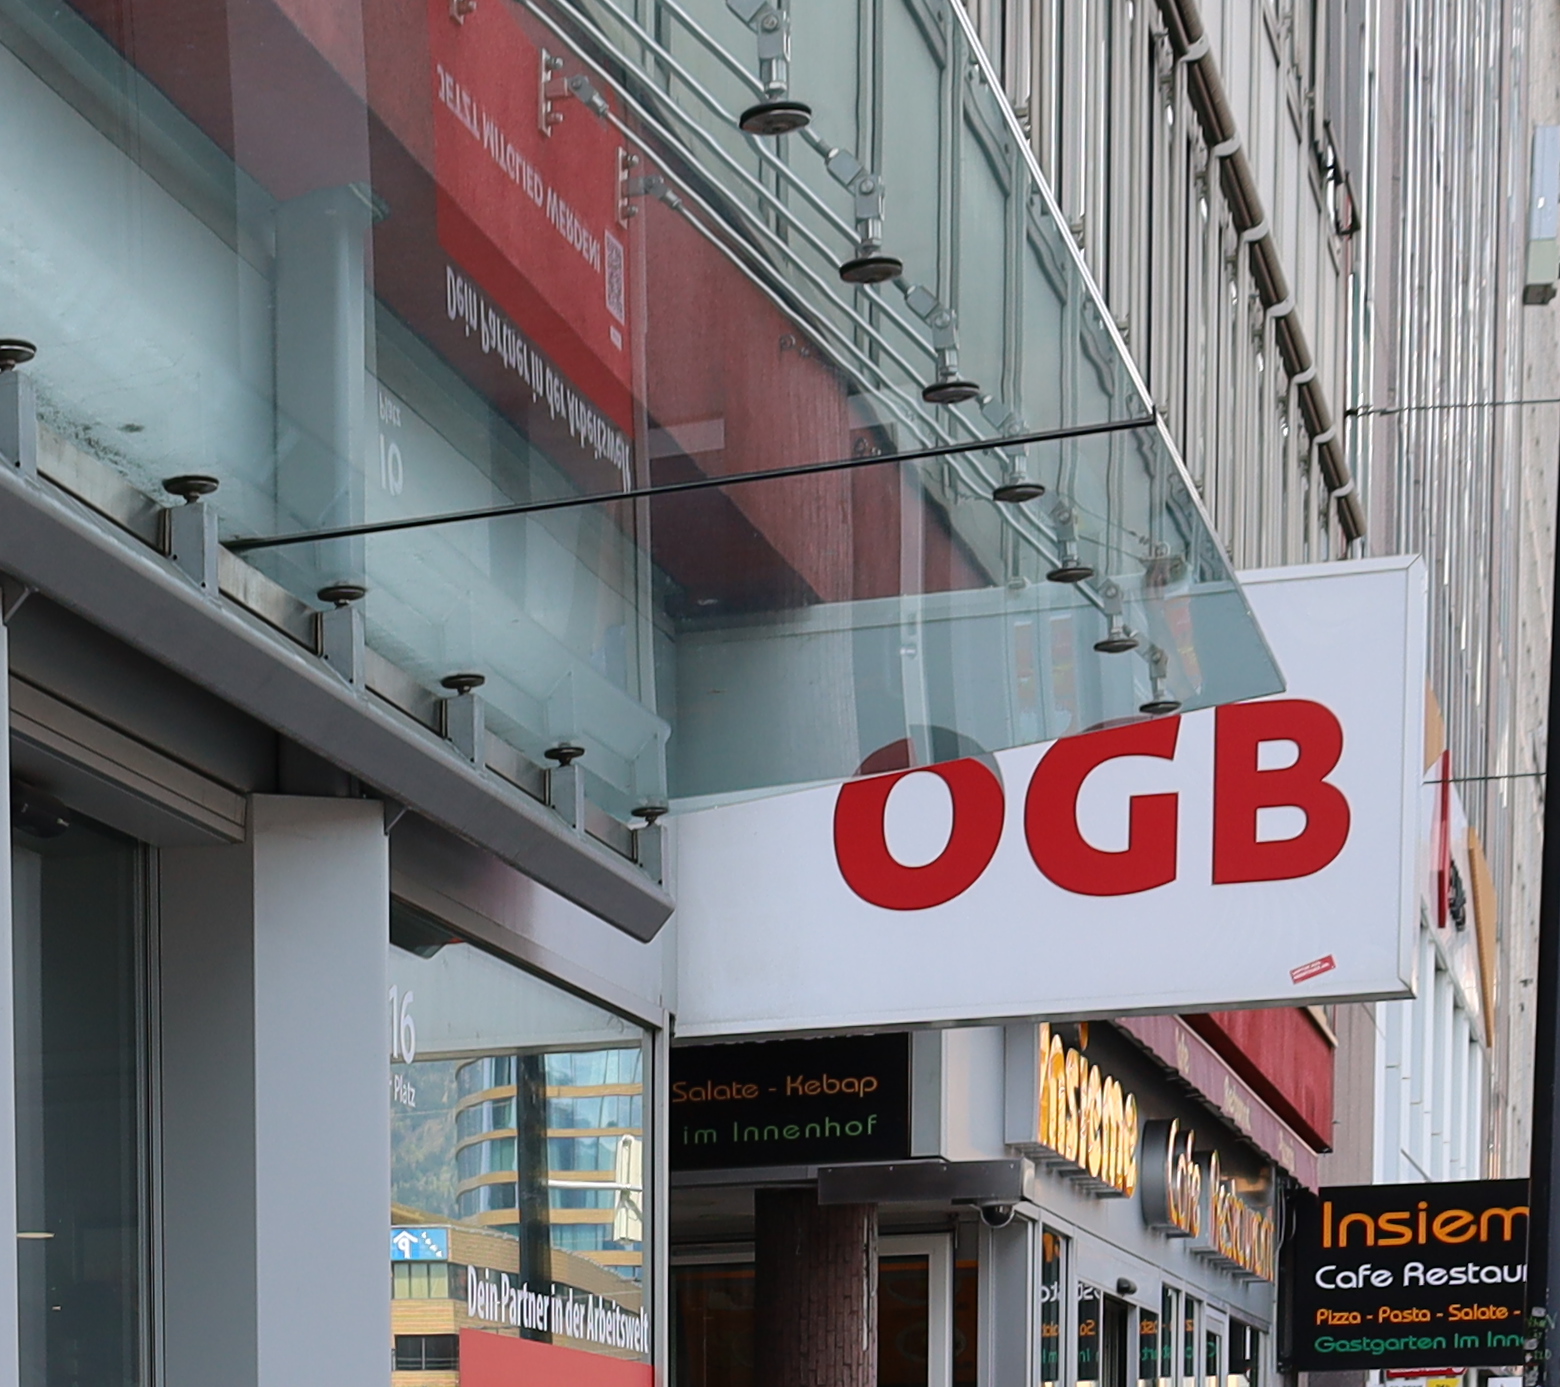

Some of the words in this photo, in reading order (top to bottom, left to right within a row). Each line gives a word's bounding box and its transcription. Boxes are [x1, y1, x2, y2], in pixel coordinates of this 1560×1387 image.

[389, 984, 416, 1064] 16
[671, 1080, 759, 1103] Salate
[786, 1073, 878, 1099] Kebap
[683, 1126, 717, 1146] im
[733, 1113, 879, 1142] Innenhof
[1314, 1263, 1394, 1289] Cafe
[466, 1264, 498, 1319] Dein
[500, 1272, 550, 1333] Partner
[551, 1284, 564, 1334] in
[565, 1288, 586, 1339] der
[586, 1295, 649, 1354] Arbeitswelt
[1316, 1308, 1362, 1325] Pizza
[1379, 1305, 1431, 1323] Pasta
[1448, 1303, 1509, 1321] Salate
[1314, 1334, 1447, 1356] Gastgarten
